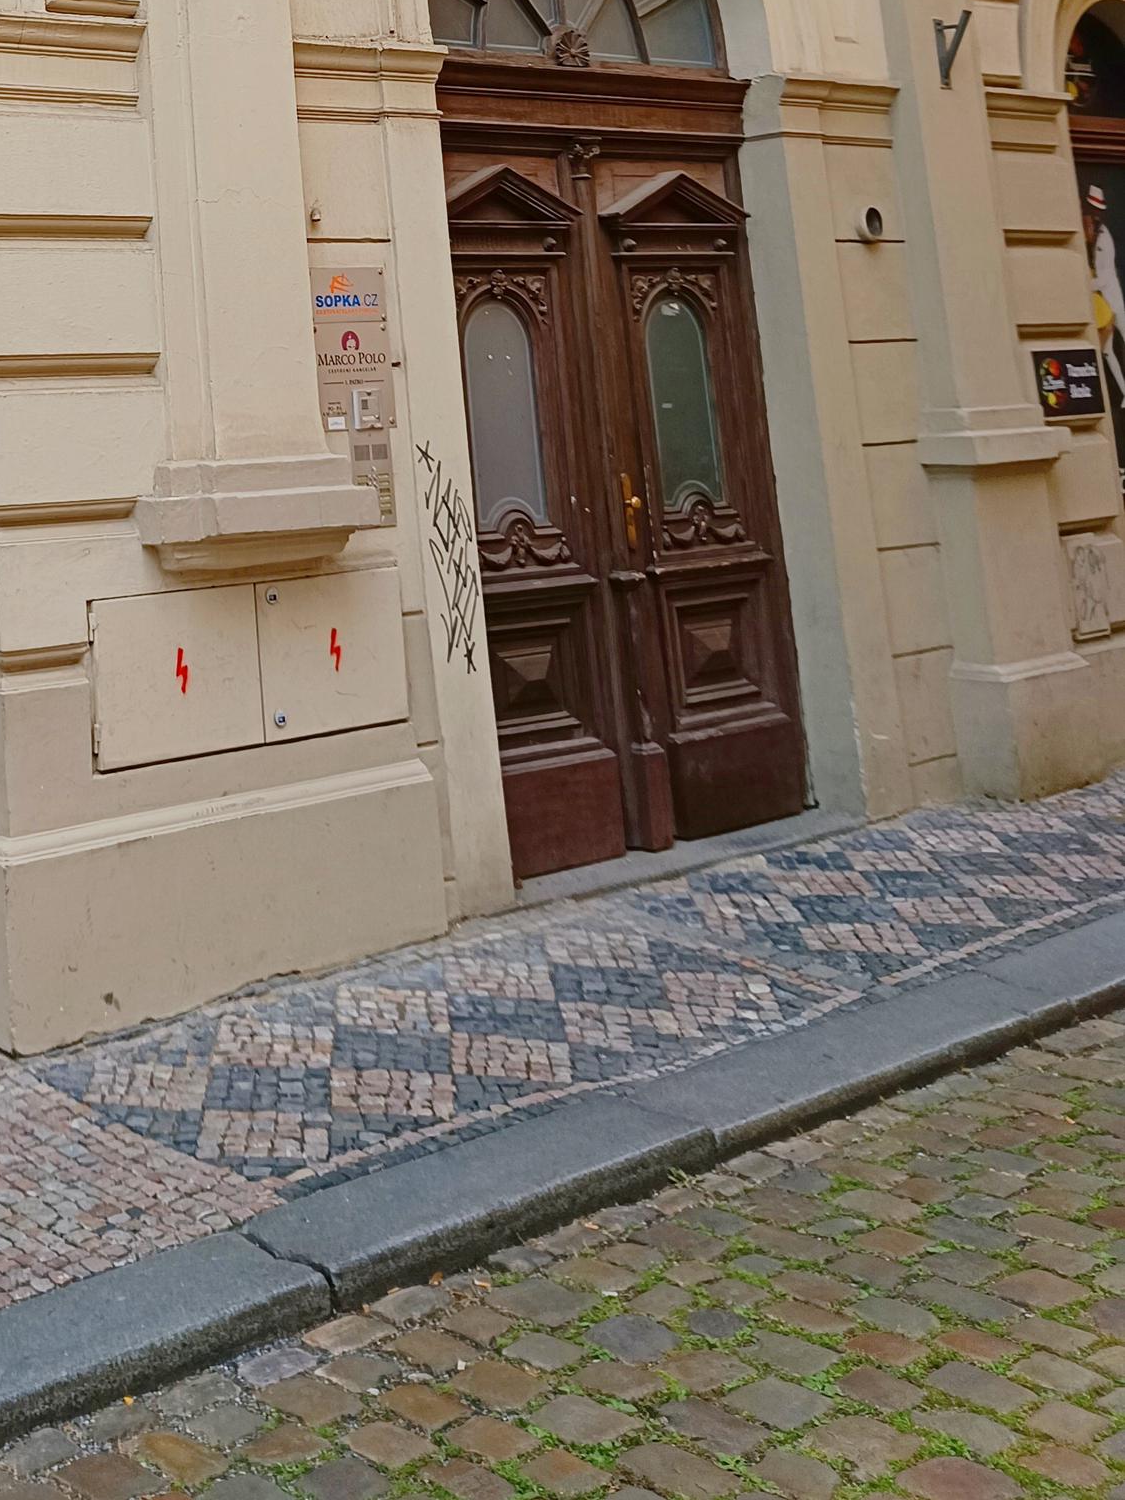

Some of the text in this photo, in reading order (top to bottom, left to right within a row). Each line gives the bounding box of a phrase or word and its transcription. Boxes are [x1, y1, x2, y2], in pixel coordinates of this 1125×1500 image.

[315, 293, 379, 307] SOPKA CZ
[318, 352, 386, 366] MARCO POLO
